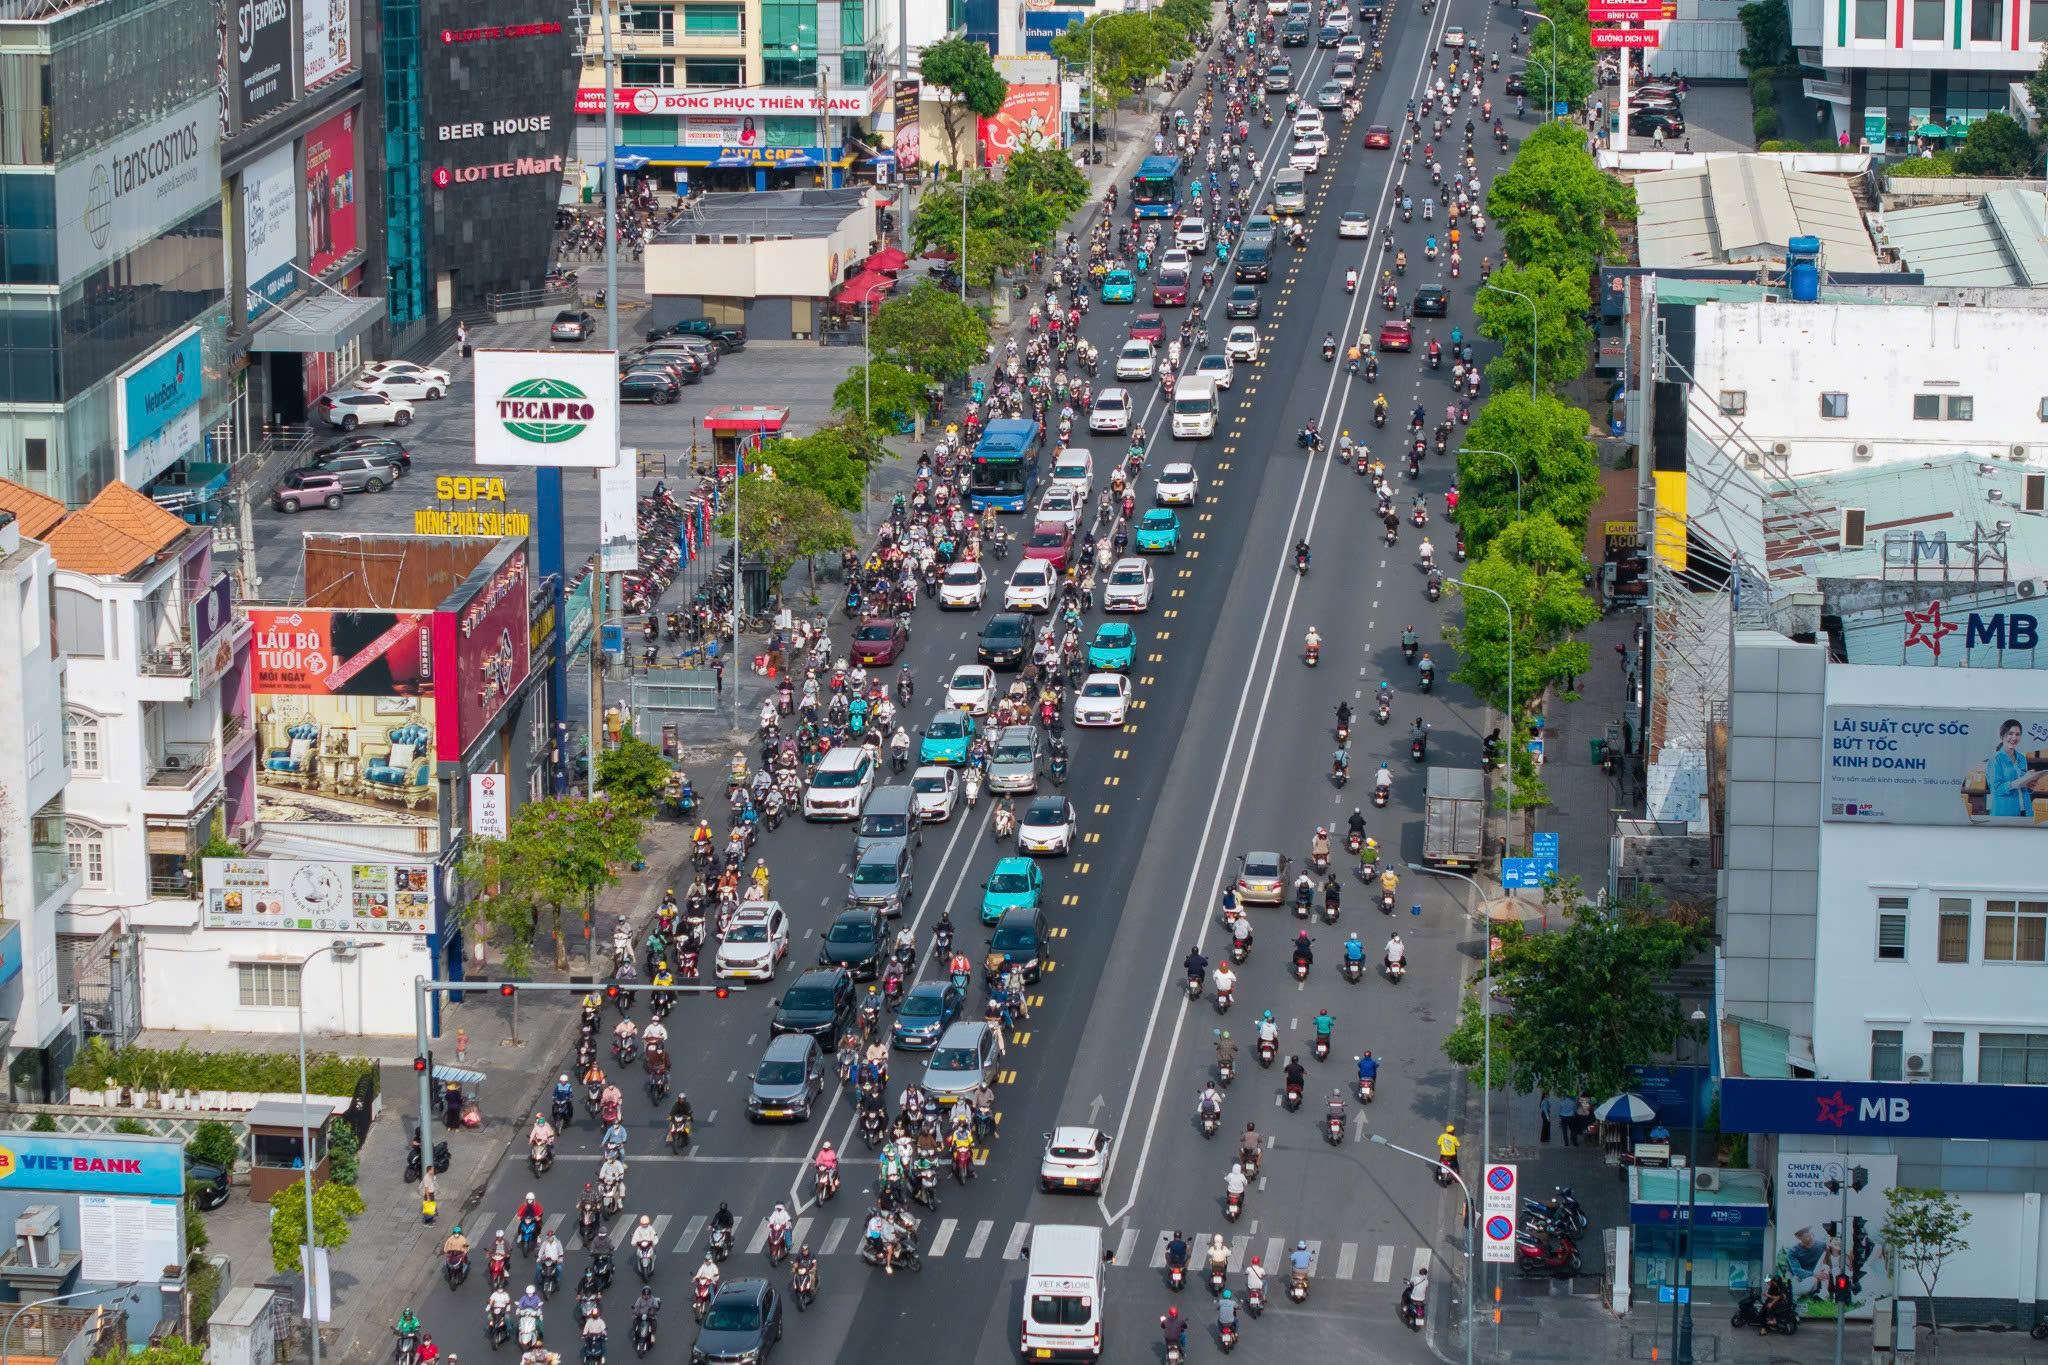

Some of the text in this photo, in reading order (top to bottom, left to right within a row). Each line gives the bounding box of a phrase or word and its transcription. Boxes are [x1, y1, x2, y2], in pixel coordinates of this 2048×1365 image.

[255, 0, 286, 31] EXPRESS
[453, 22, 562, 42] LOTTE CINEMA
[1625, 35, 1641, 43] DỊCH
[1643, 35, 1654, 43] VỤ
[583, 92, 620, 101] HOTLE
[665, 95, 860, 112] ĐỒNG PHỤC THIÊN TRANG
[439, 116, 551, 141] BEER HOUSE
[113, 121, 198, 198] transcosmos
[455, 154, 562, 183] LOTTE Mart
[144, 378, 178, 416] VietinBank
[496, 401, 595, 421] TECAPRO
[436, 476, 506, 501] SOFA
[257, 625, 320, 650] LẨU BÒ
[1966, 613, 2039, 650] MB
[258, 648, 302, 669] TƯƠI
[1833, 718, 1969, 738] LÃI SUẤT CỰC SỐC
[1833, 735, 1898, 751] BỨT TỐC
[1832, 756, 1926, 769] KINH DOANH
[1832, 775, 1845, 783] Vay
[387, 921, 412, 931] FDA
[1859, 1098, 1910, 1123] MB
[20, 1154, 142, 1175] VIETBANK
